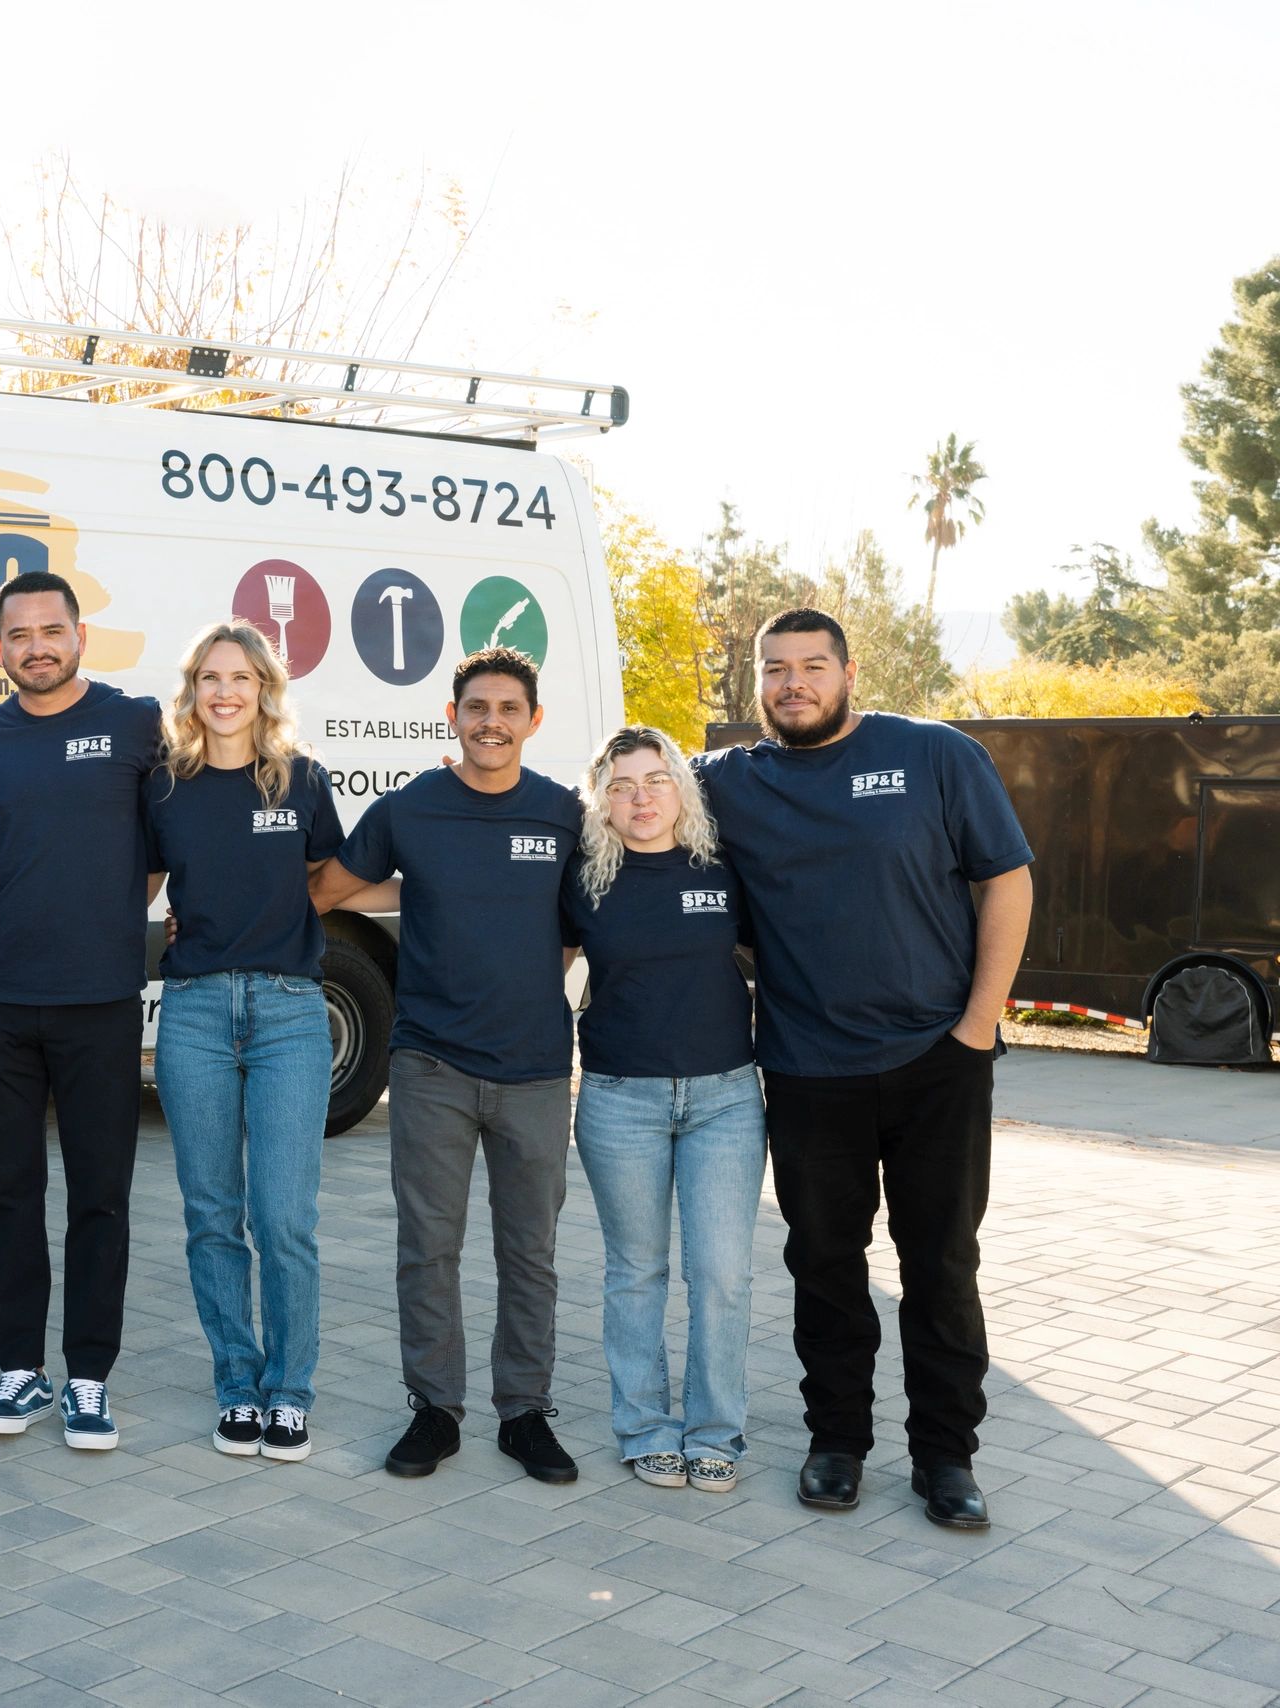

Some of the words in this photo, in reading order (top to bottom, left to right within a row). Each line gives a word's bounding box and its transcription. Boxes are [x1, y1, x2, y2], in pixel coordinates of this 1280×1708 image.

[161, 449, 556, 530] 800-493-8724
[326, 719, 458, 740] ESTABLISHED
[66, 737, 111, 755] SP&C
[852, 772, 905, 791] SP&C
[252, 811, 297, 826] SP&C
[511, 838, 556, 855] SP&C
[681, 892, 727, 907] SP&C
